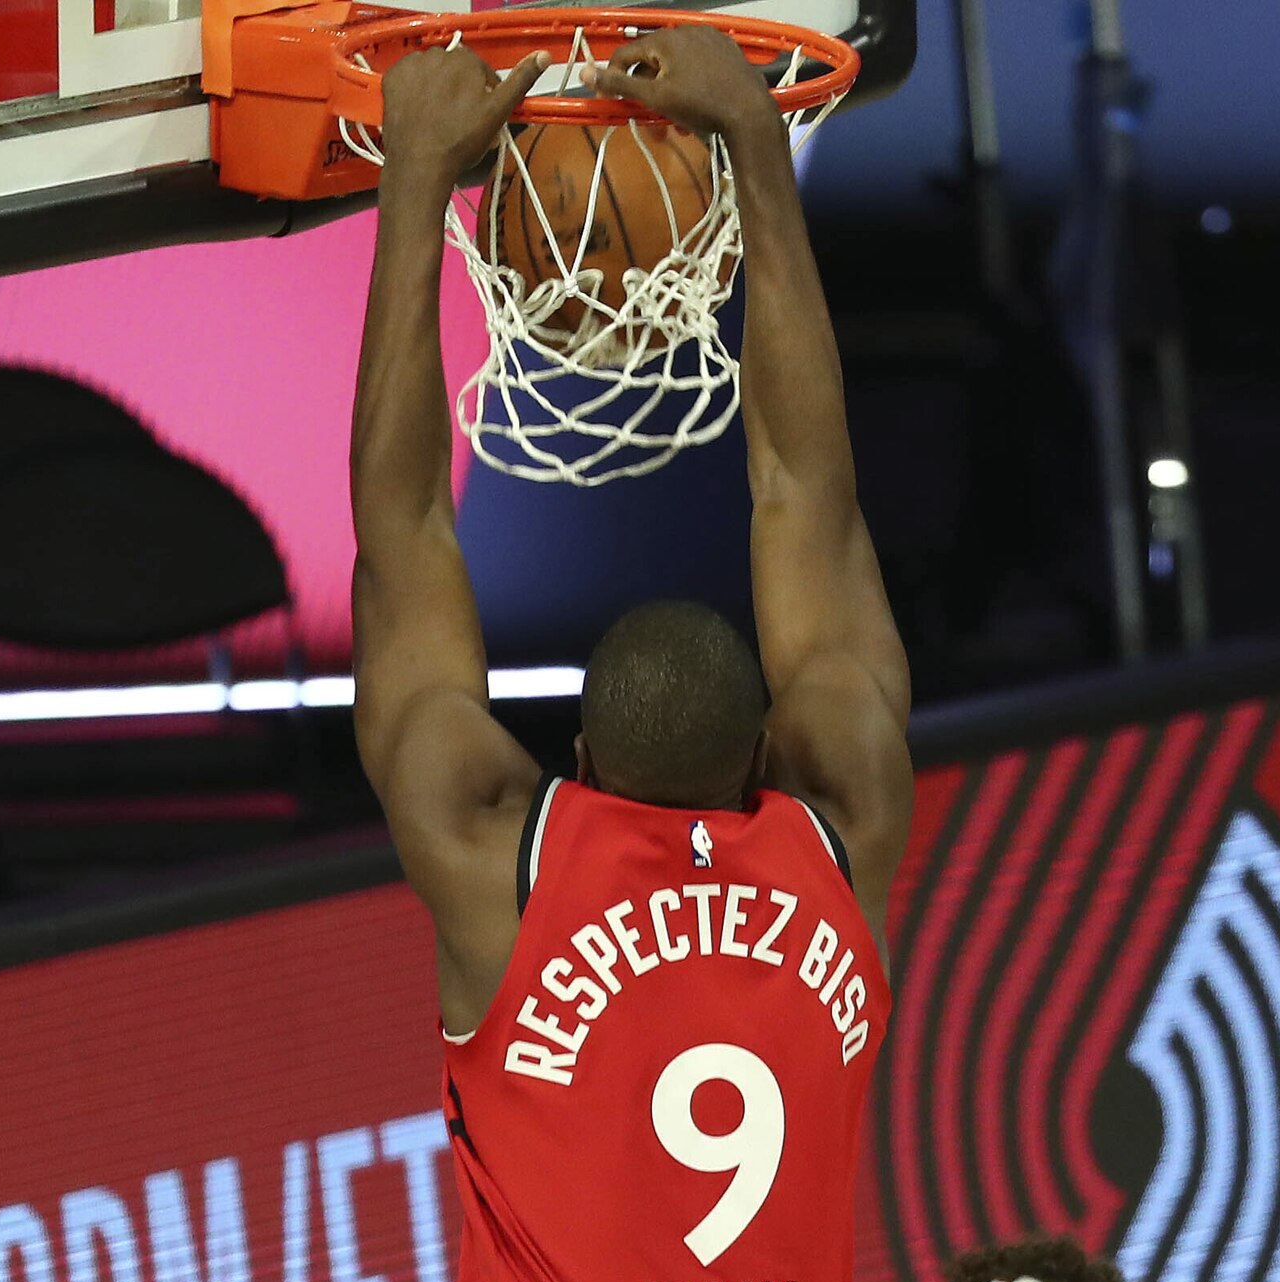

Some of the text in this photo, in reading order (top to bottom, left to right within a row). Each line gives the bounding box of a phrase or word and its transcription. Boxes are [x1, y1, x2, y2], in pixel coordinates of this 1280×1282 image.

[504, 883, 870, 1086] RESPECTEZ BISO
[651, 1043, 786, 1267] 9
